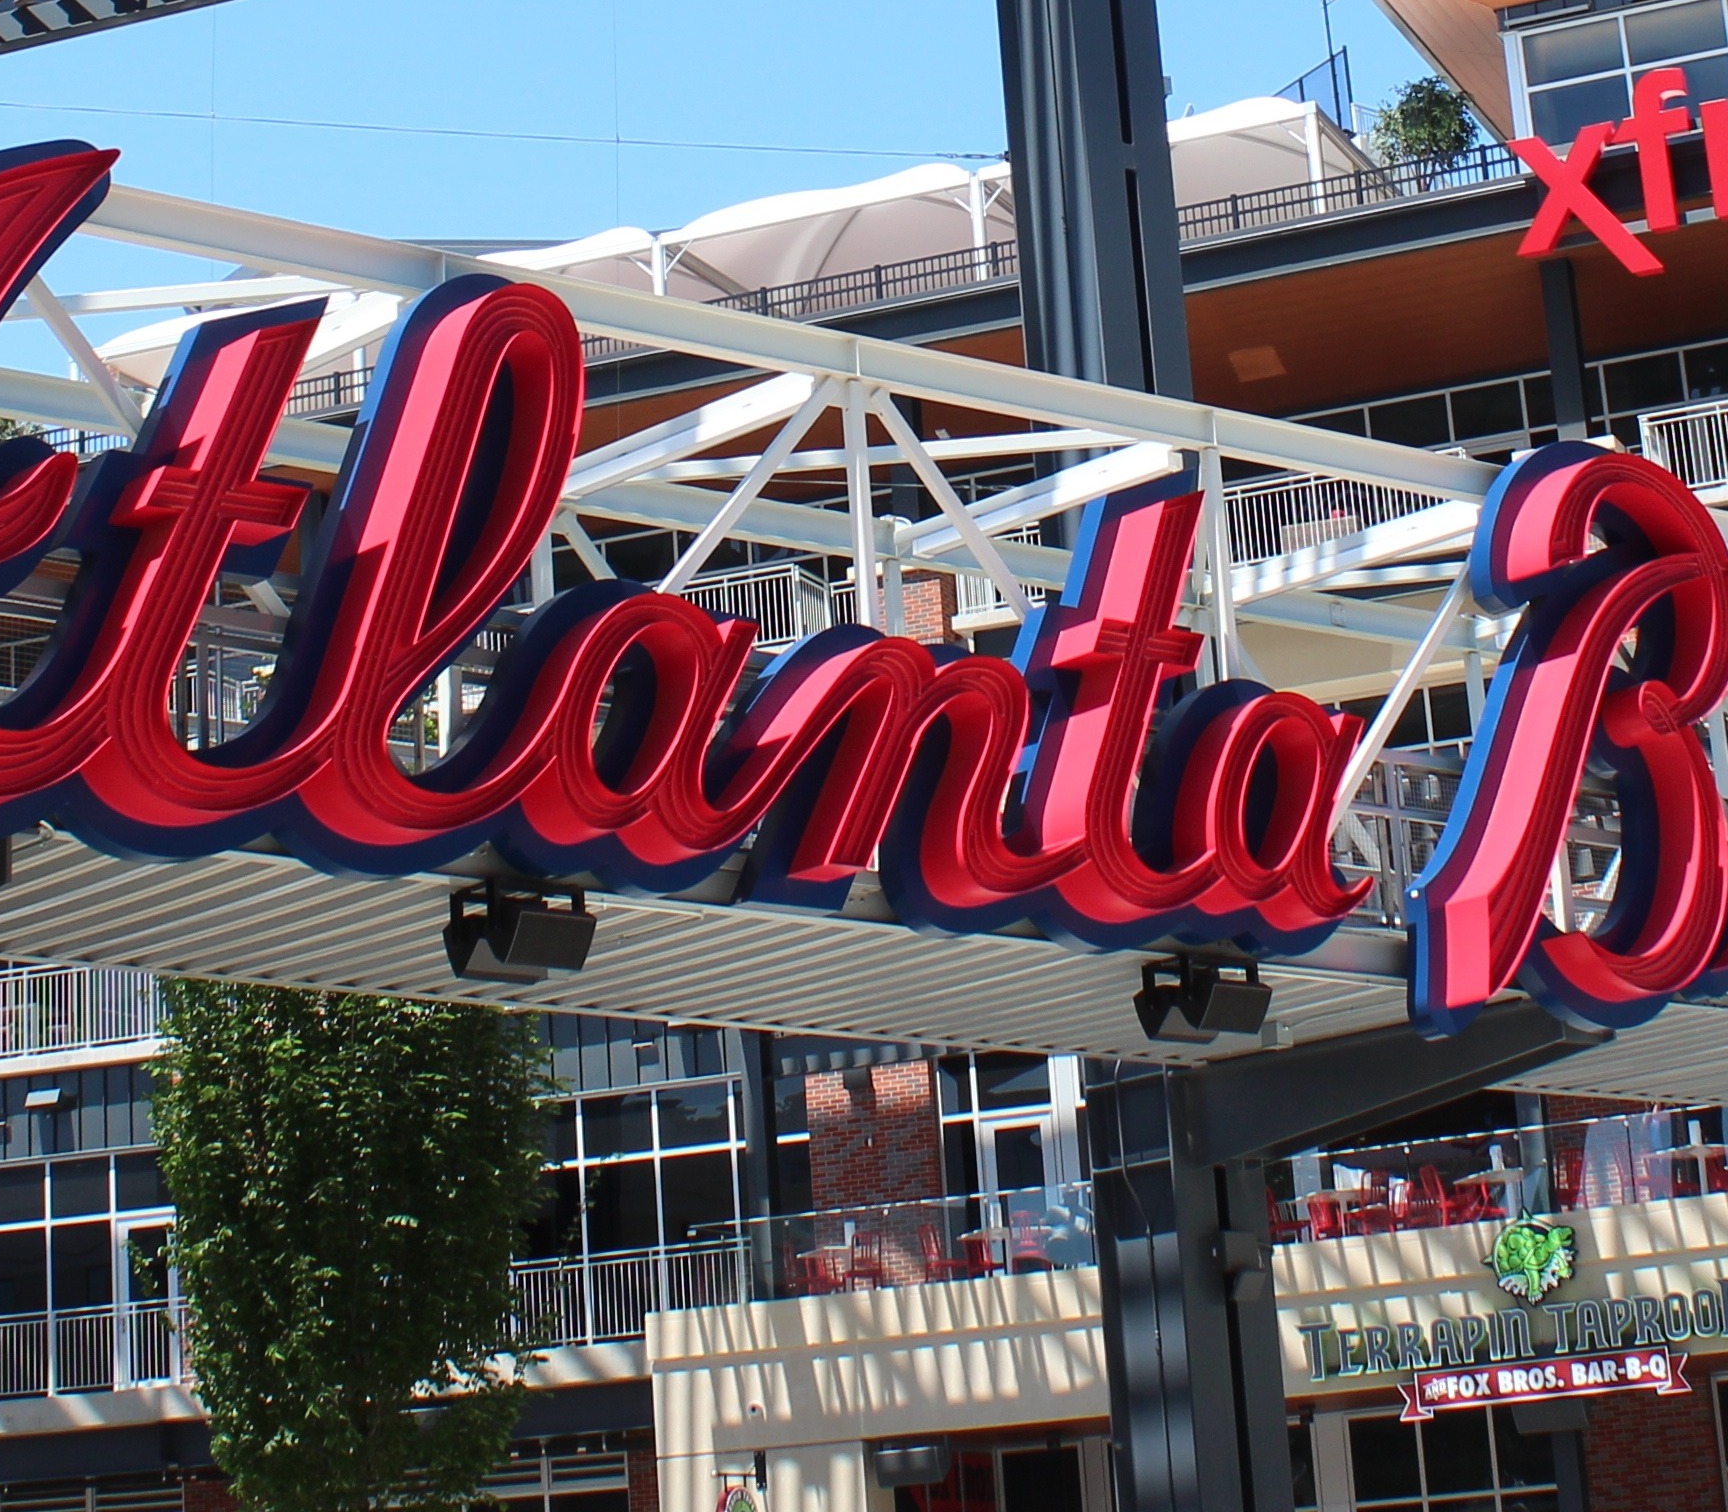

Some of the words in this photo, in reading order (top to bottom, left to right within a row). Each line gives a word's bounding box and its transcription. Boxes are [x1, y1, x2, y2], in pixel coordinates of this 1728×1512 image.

[1297, 1308, 1535, 1382] TERRAPIN
[1423, 1378, 1448, 1401] AND
[1446, 1373, 1491, 1400] FOX
[1498, 1362, 1564, 1396] BROS.
[1572, 1353, 1668, 1387] BAR-B-Q
